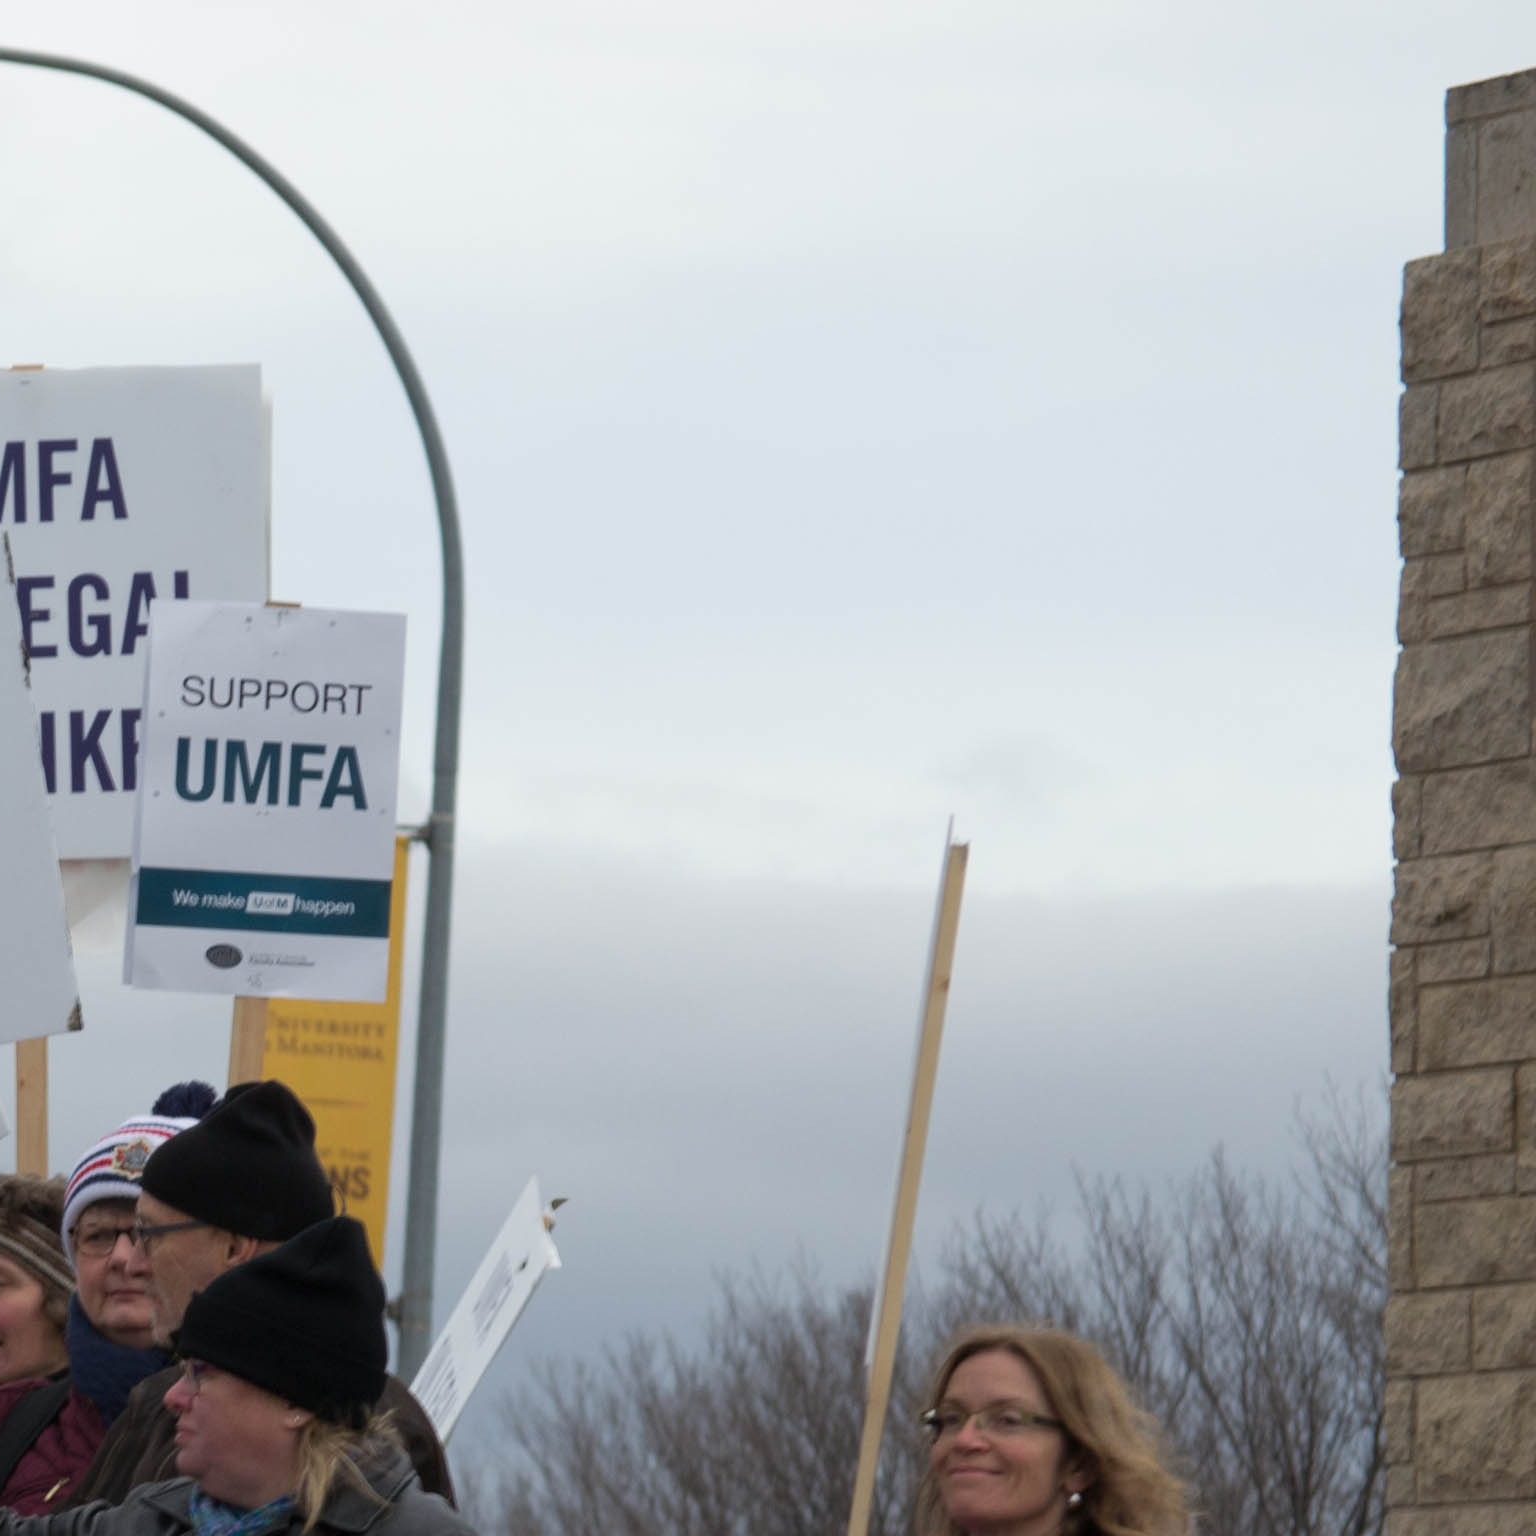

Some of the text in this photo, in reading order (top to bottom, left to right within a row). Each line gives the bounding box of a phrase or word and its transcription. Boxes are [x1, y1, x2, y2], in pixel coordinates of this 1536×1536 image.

[181, 675, 373, 715] SUPPORT
[174, 736, 369, 811] UMFA
[172, 889, 199, 905] We
[201, 891, 245, 908] make
[296, 895, 356, 917] happen
